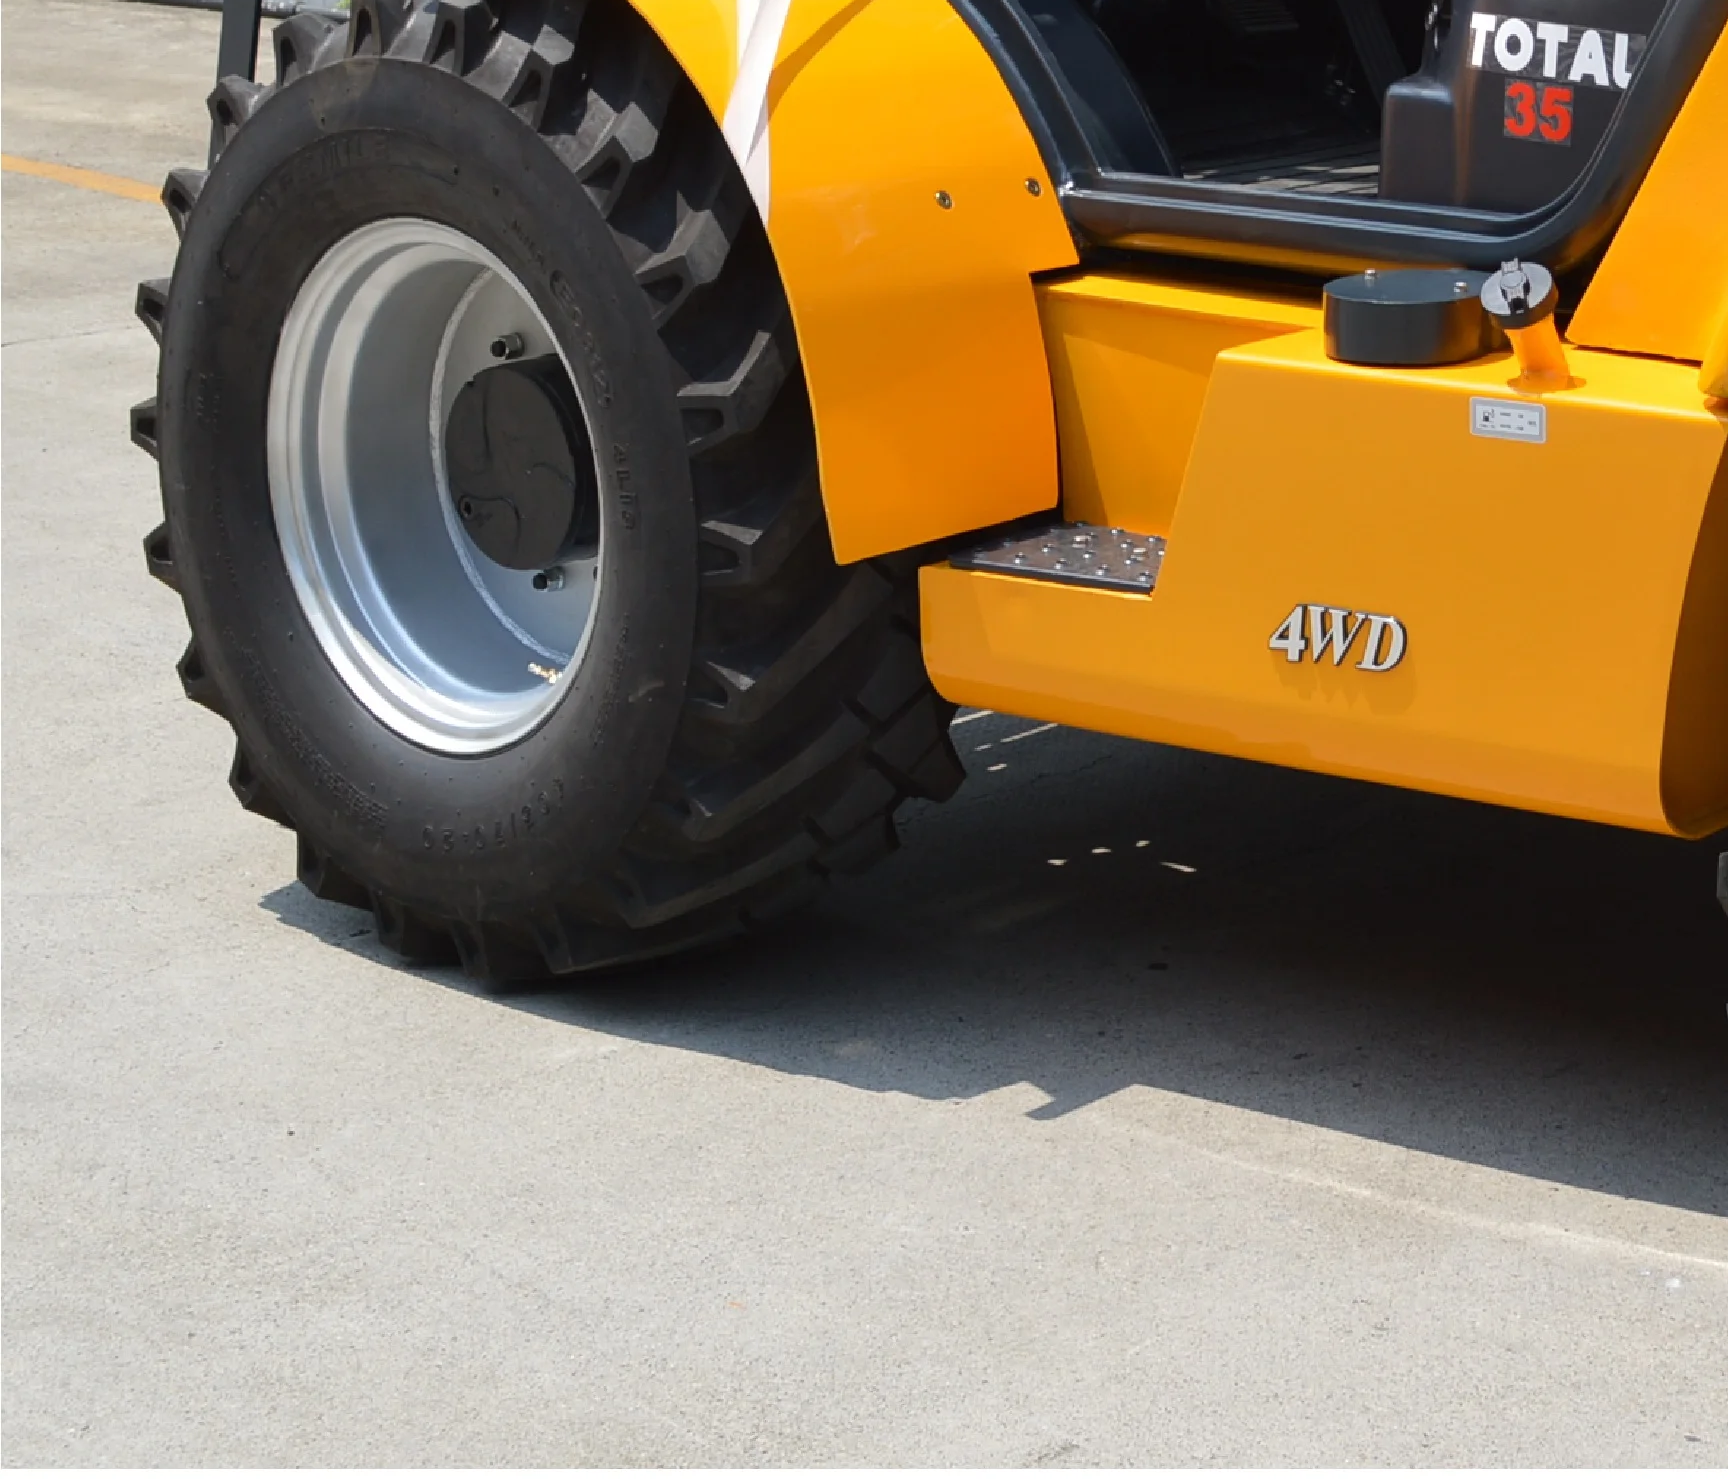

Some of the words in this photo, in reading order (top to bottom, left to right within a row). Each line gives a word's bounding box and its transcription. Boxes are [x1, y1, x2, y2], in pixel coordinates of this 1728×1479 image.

[1470, 11, 1632, 89] TOTAL
[1504, 82, 1571, 142] 35
[1268, 603, 1408, 672] 4WD
